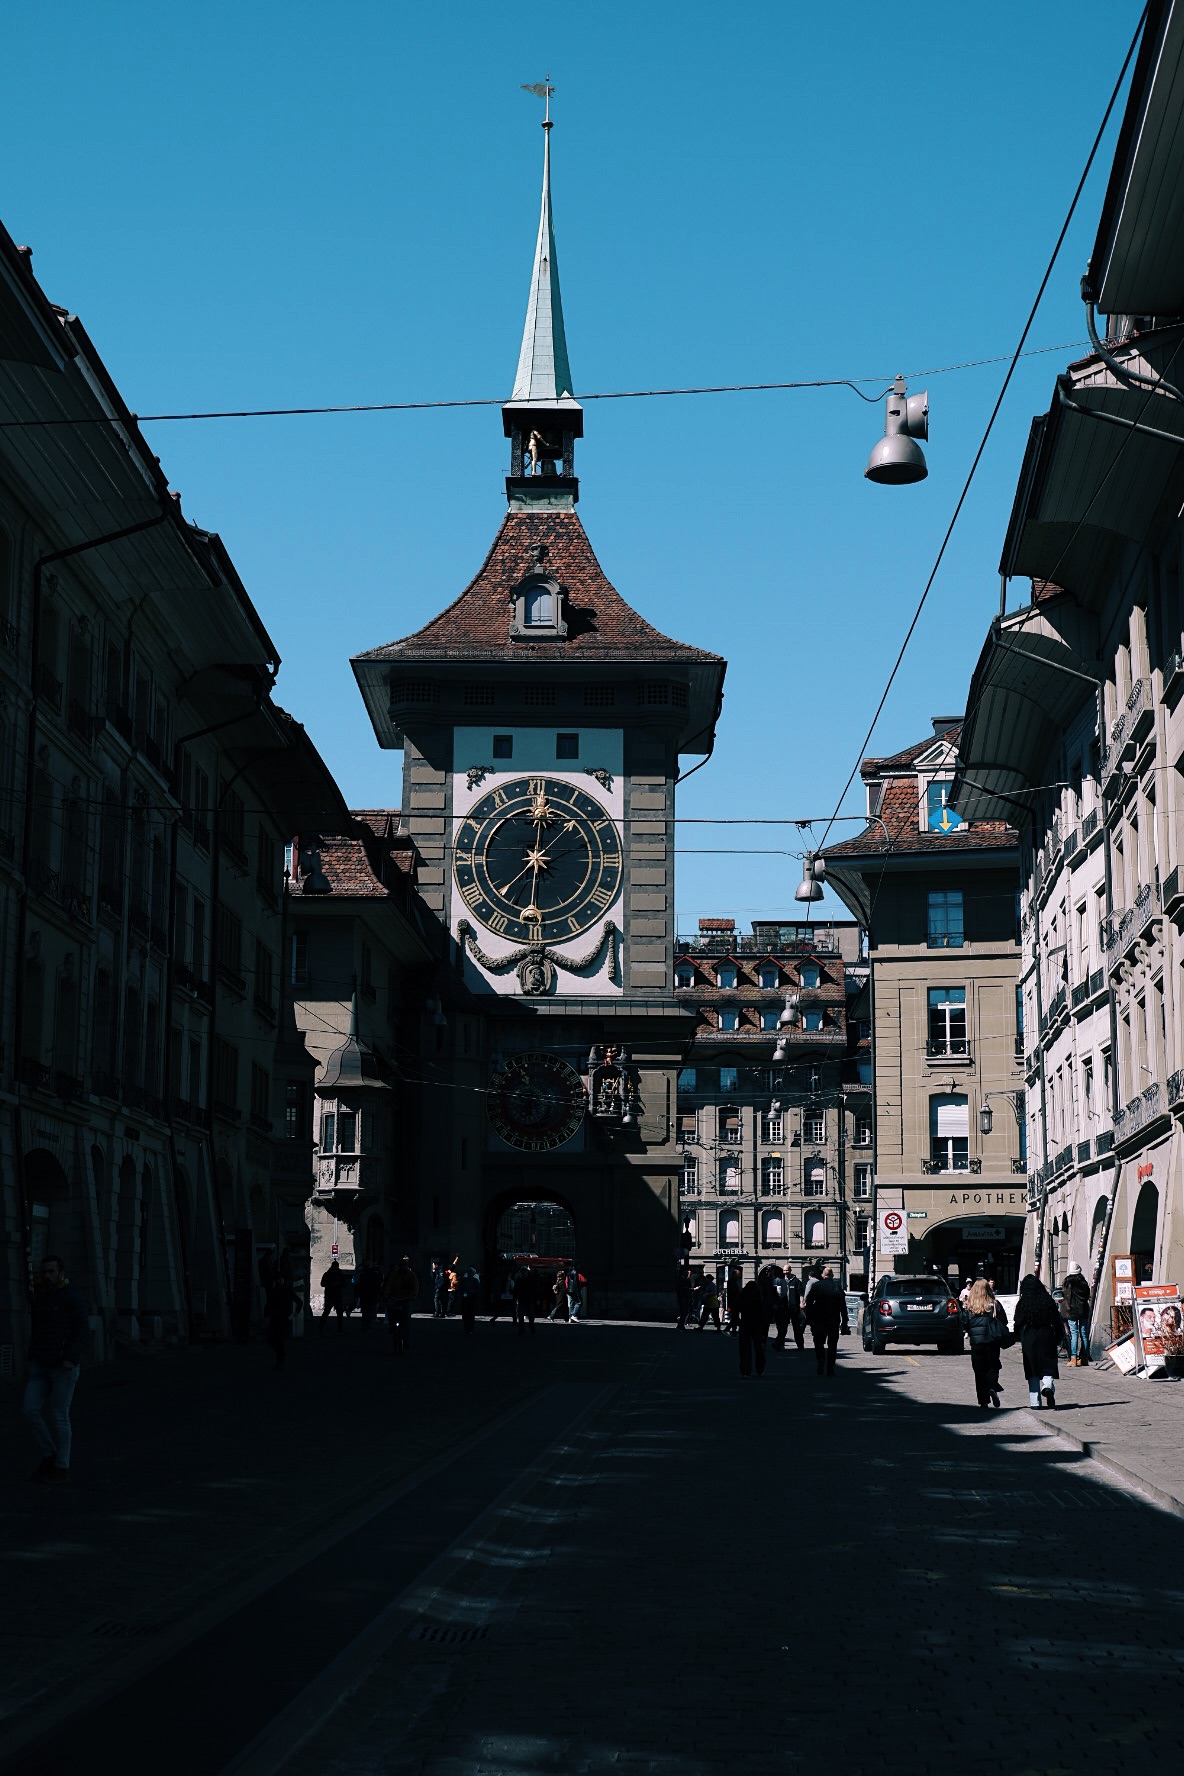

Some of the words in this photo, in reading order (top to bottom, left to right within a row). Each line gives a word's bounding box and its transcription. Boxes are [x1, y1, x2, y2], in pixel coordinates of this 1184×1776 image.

[527, 779, 546, 795] XII
[492, 789, 509, 809] XI
[570, 791, 579, 805] I
[593, 815, 610, 831] II
[456, 849, 472, 865] IX
[602, 852, 620, 868] III
[462, 882, 484, 908] VIII
[590, 886, 612, 908] IIII
[487, 911, 509, 933] VII
[528, 924, 543, 941] VI
[949, 1193, 1028, 1204] APOTHEK
